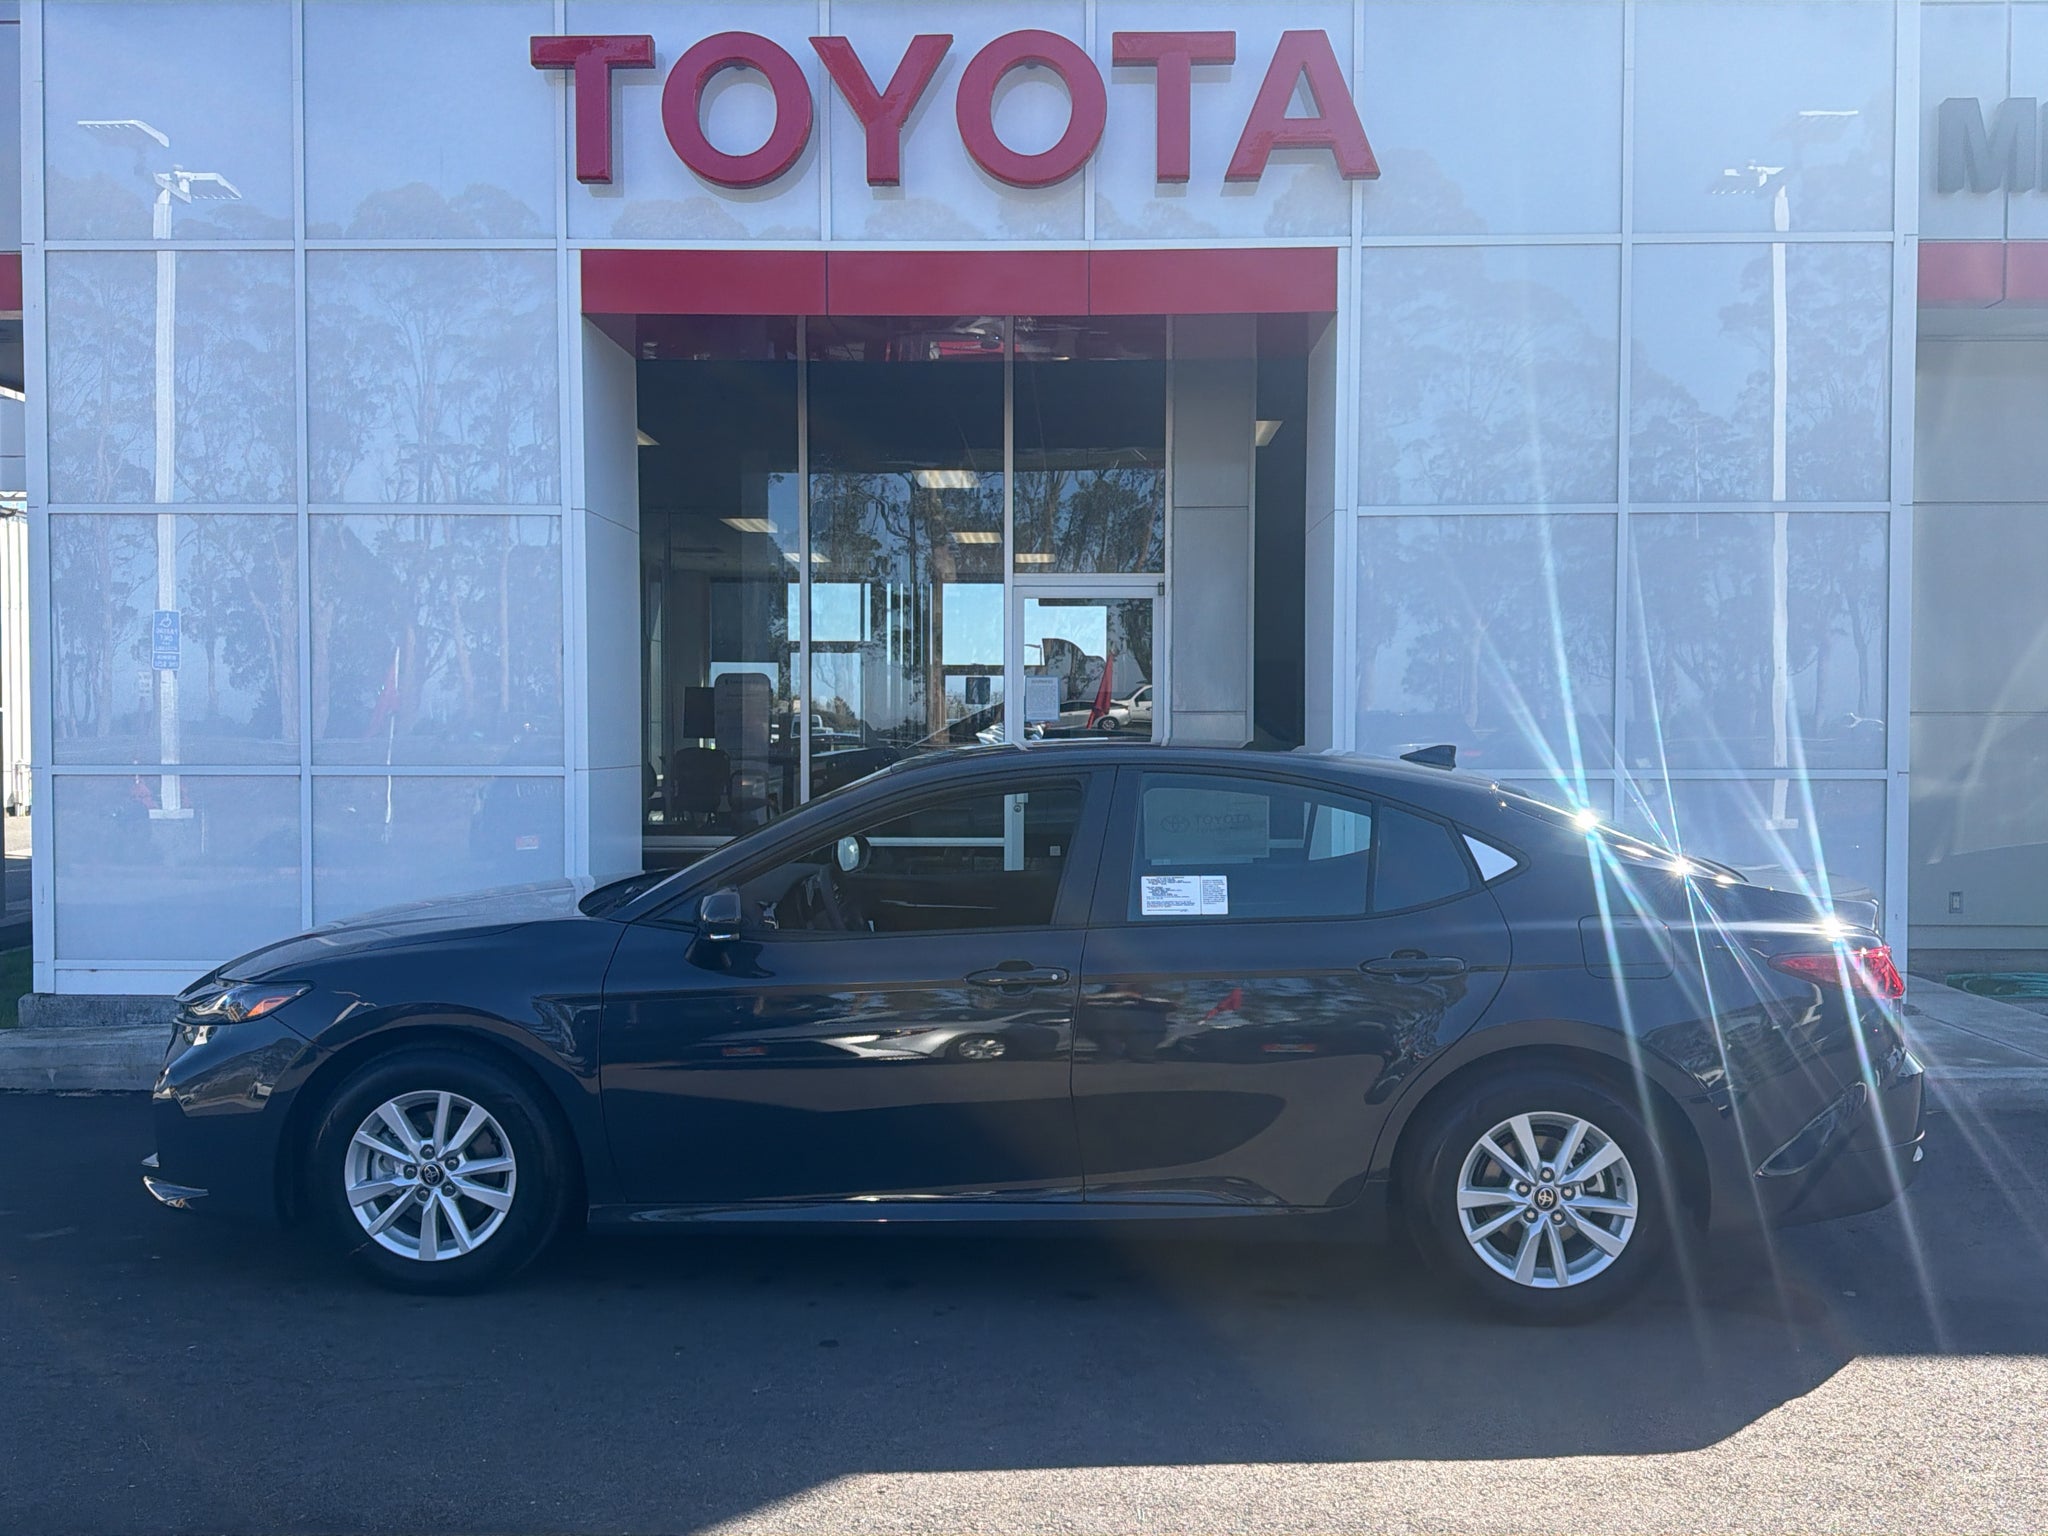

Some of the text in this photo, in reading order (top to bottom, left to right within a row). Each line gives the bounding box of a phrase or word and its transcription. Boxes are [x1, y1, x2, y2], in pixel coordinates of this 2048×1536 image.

[530, 29, 1380, 188] TOYOTA
[1937, 97, 2048, 194] M
[1194, 813, 1253, 825] TOYOTA
